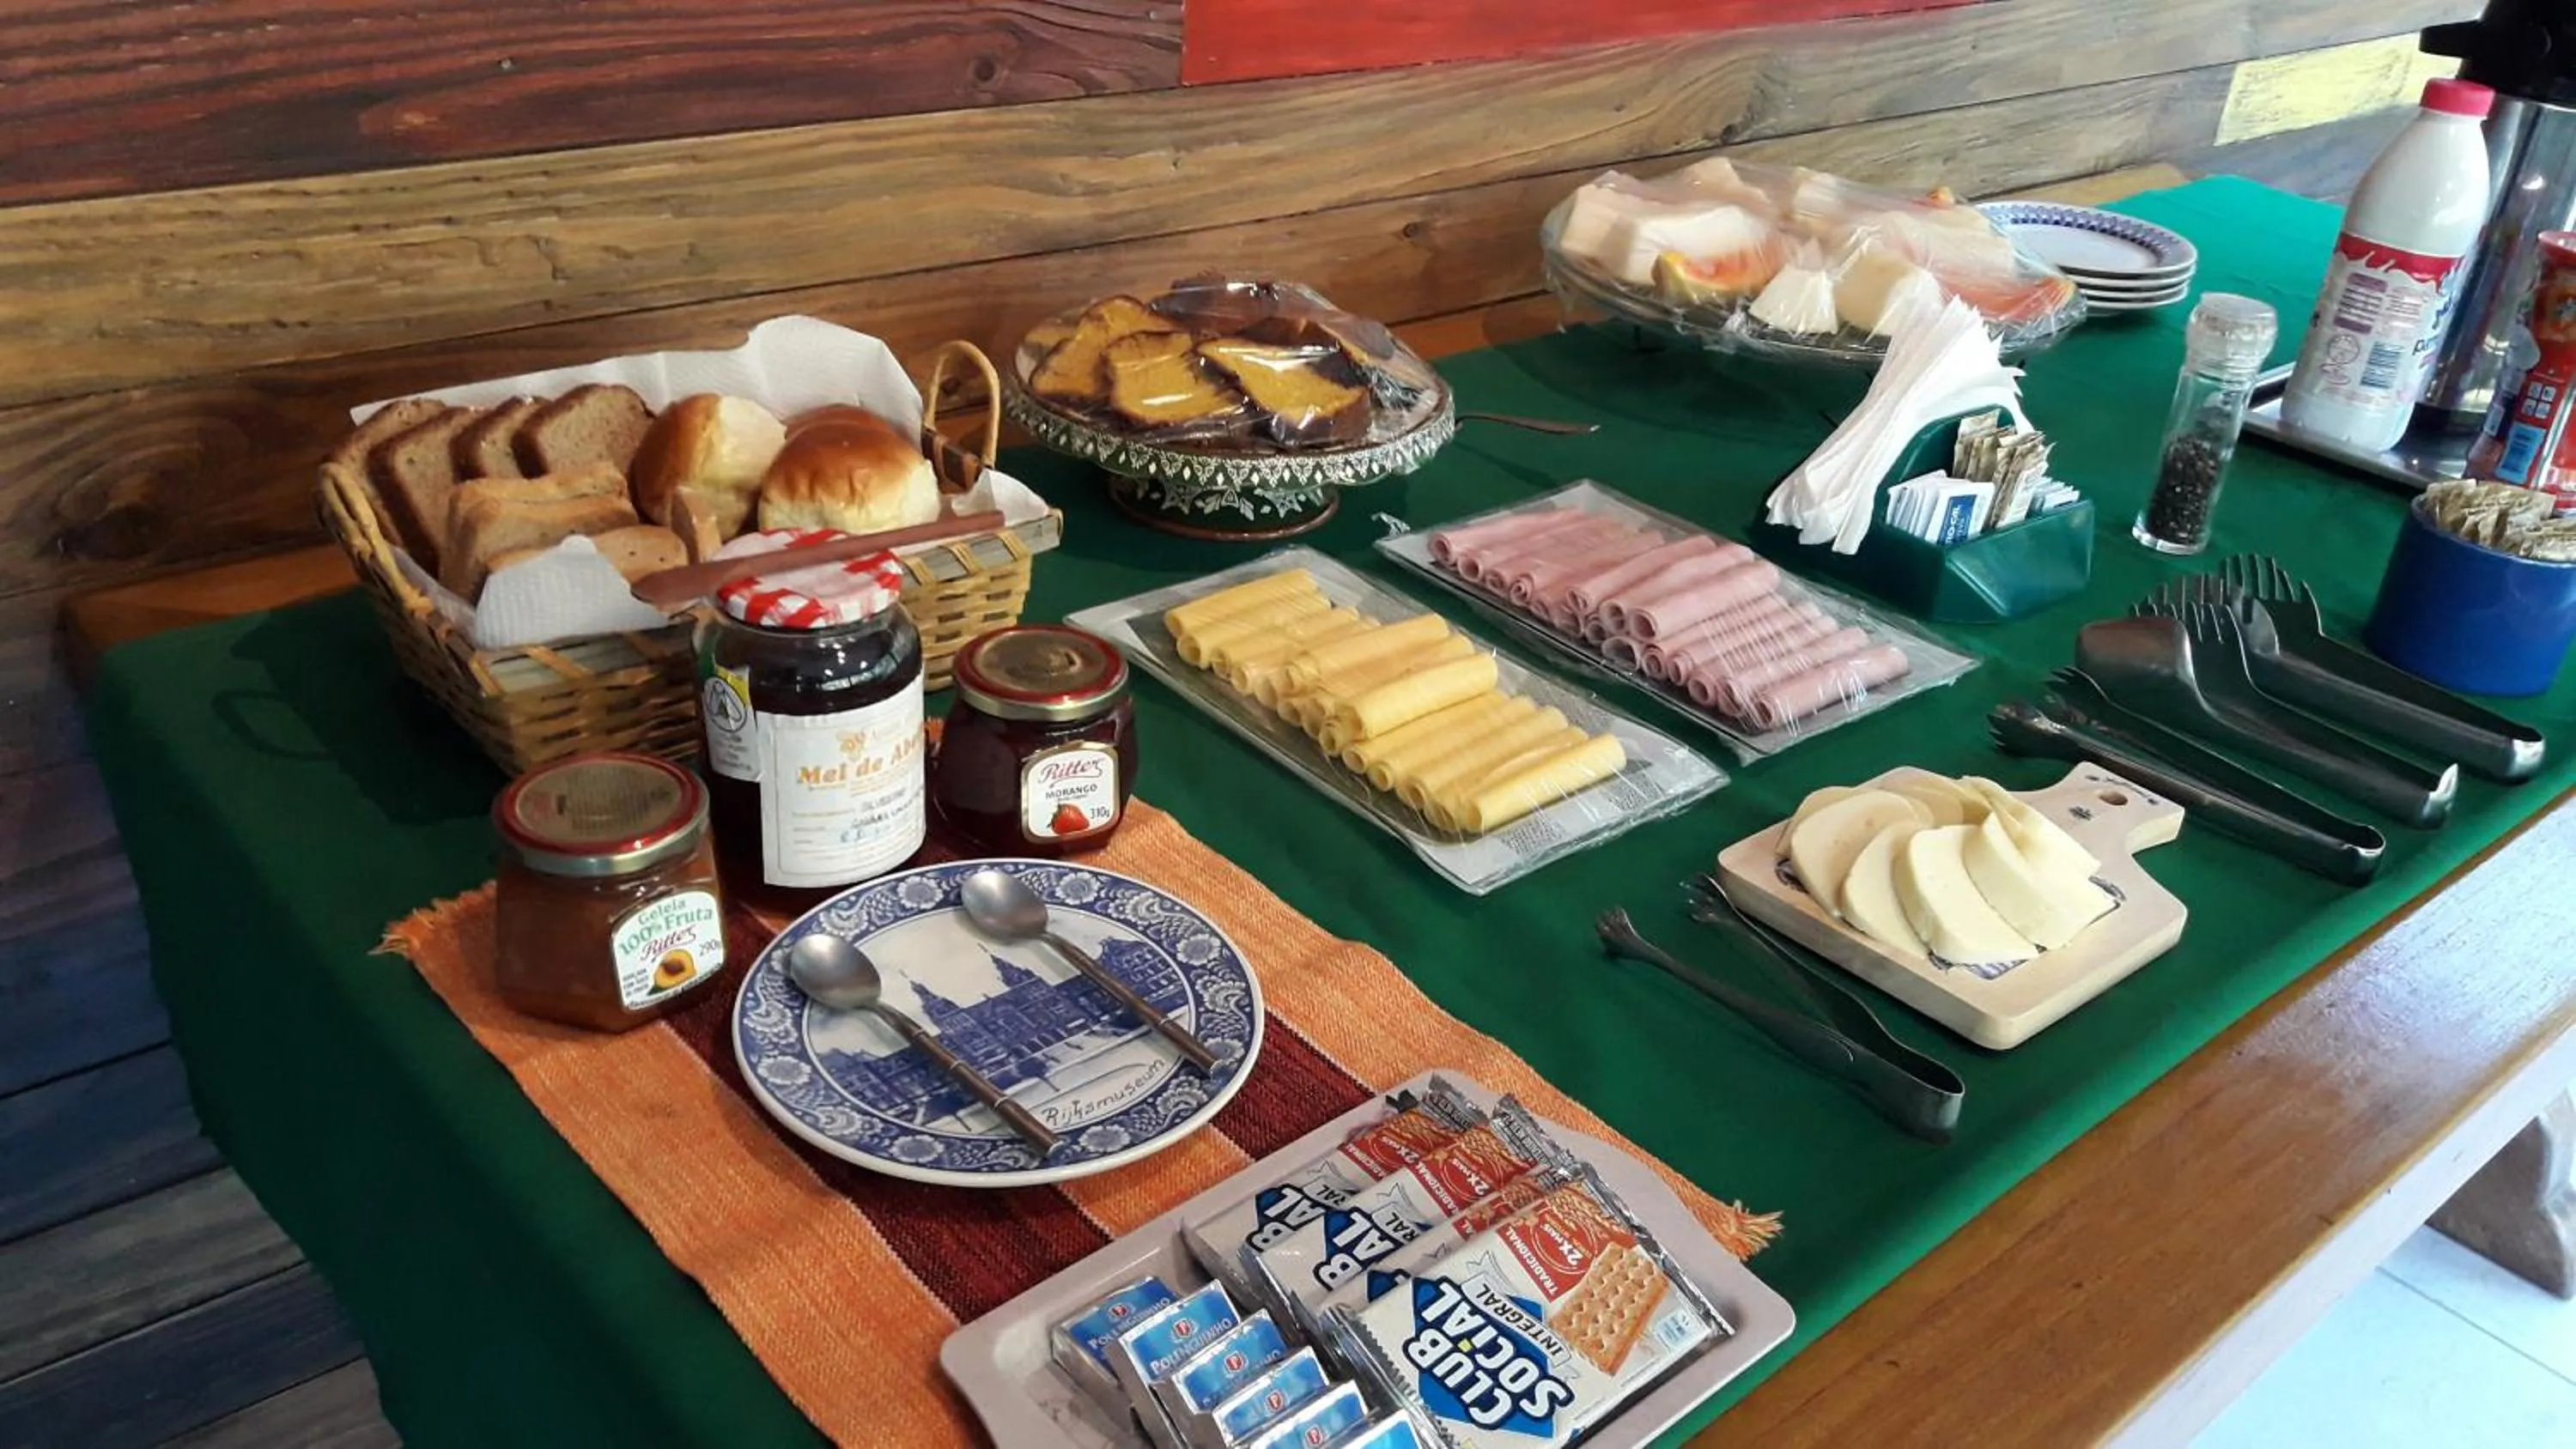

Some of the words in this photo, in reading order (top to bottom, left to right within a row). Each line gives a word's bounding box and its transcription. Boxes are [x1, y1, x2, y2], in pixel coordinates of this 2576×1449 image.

[798, 763, 847, 786] Mel
[855, 755, 884, 777] de
[1037, 757, 1105, 788] Ritter
[1045, 783, 1098, 800] MORANGO
[664, 907, 714, 931] Fruta
[1041, 1057, 1166, 1126] Rijksmuseum
[1467, 1173, 1491, 1197] 2X
[1504, 1225, 1558, 1294] TRADICIONAL
[1558, 1240, 1584, 1266] 2X
[1476, 1282, 1564, 1357] INTEGRAL
[1407, 1328, 1513, 1425] CLUB
